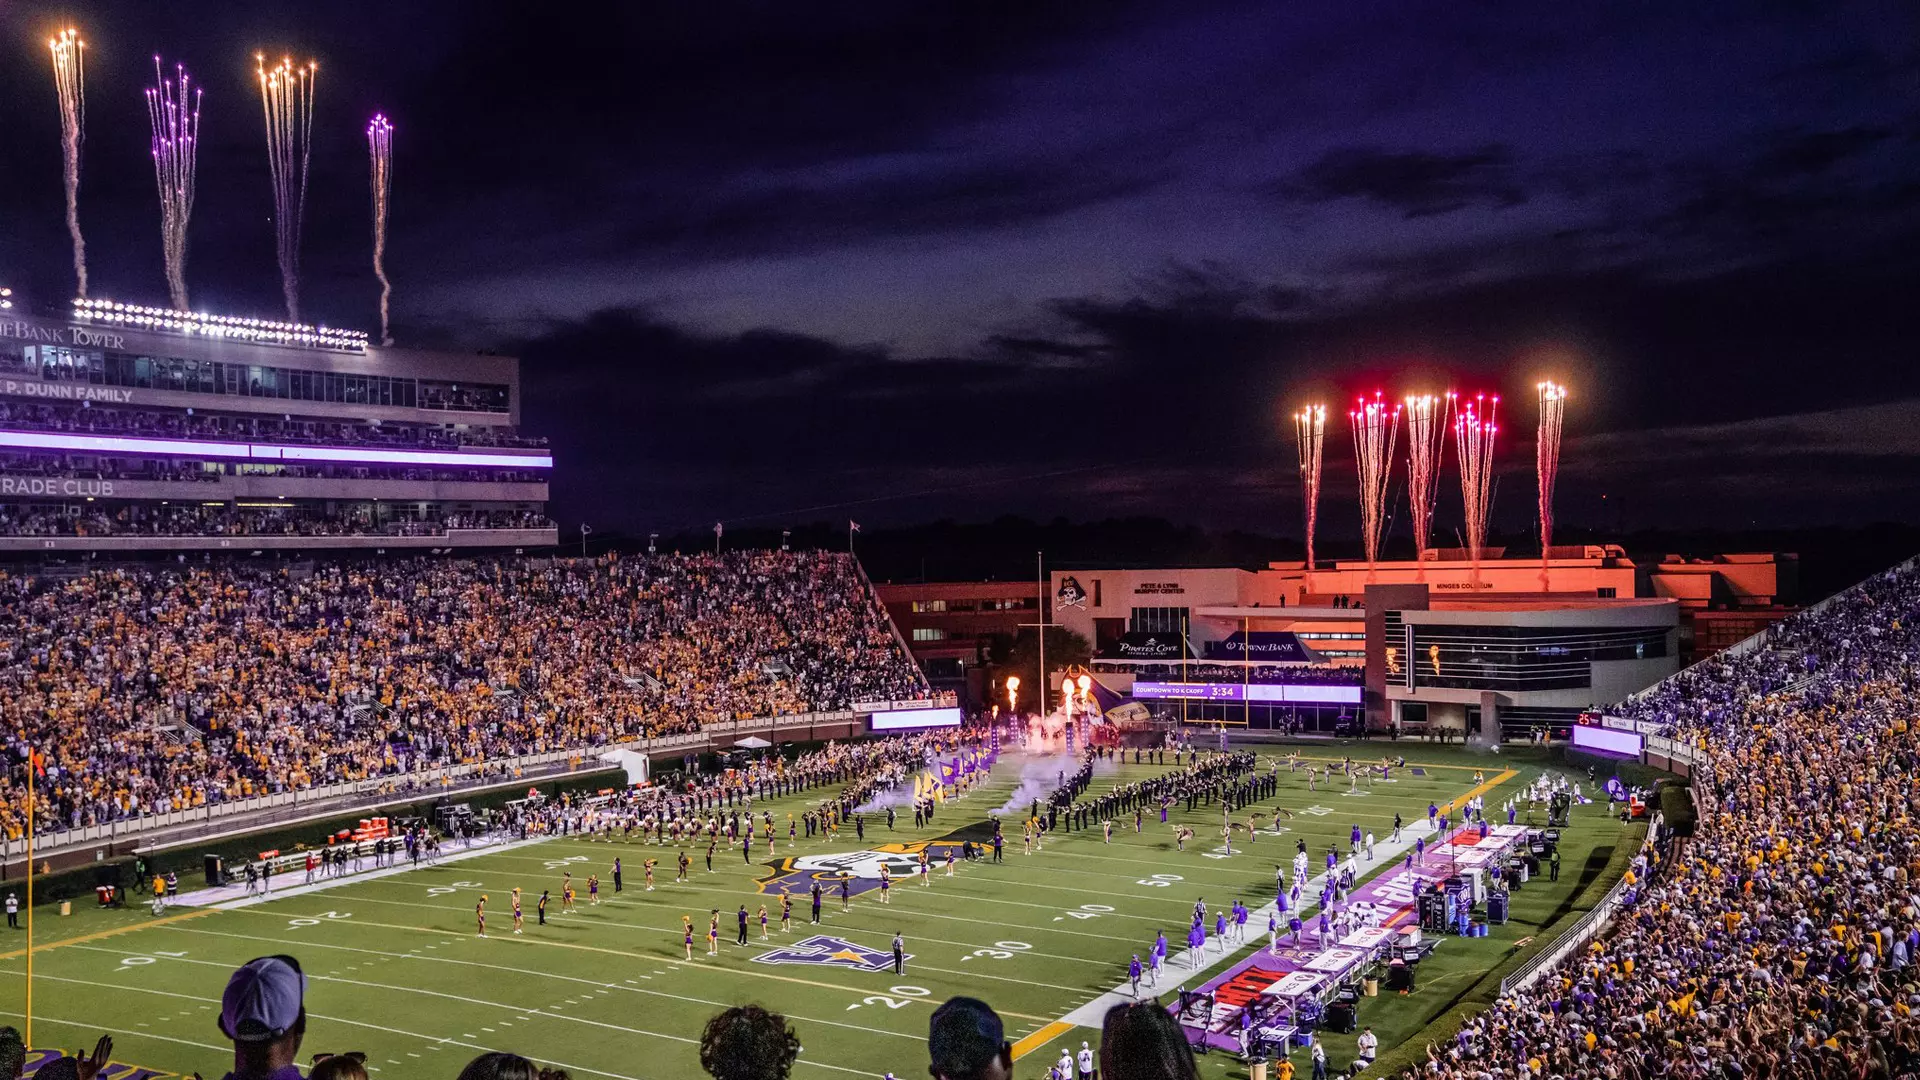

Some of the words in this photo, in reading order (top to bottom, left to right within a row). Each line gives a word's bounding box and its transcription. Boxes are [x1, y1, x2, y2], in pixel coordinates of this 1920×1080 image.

[67, 327, 125, 349] TOWER
[25, 383, 72, 398] DUNN
[75, 387, 133, 403] FAMILY
[63, 480, 114, 496] CLUB
[1156, 643, 1179, 653] COVE
[1212, 687, 1234, 697] 3:34
[1578, 713, 1590, 725] 25
[1136, 873, 1185, 888] 50
[287, 910, 352, 927] 20
[1065, 904, 1115, 921] 40
[120, 951, 189, 966] 10
[973, 941, 1033, 960] 30
[864, 985, 932, 1010] 20
